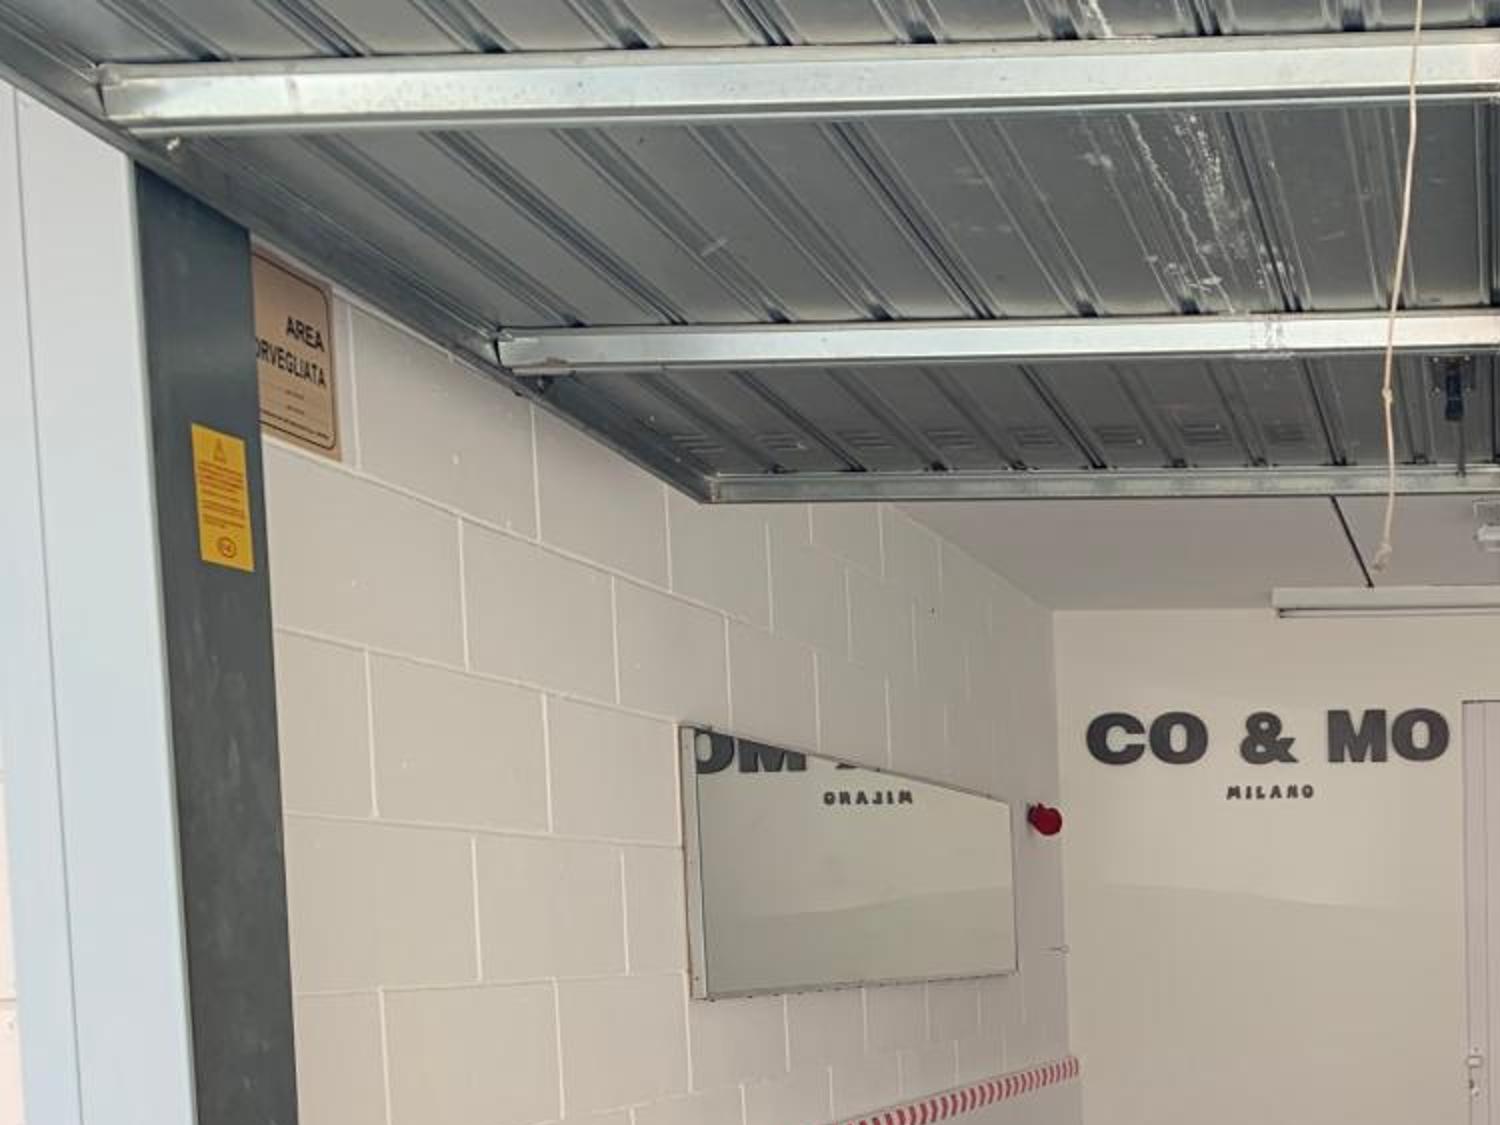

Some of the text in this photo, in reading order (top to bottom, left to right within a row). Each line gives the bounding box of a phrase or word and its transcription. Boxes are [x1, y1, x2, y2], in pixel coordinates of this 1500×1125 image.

[285, 316, 325, 352] AREA
[1086, 708, 1451, 766] CO & MO
[1226, 784, 1315, 800] MILANO
